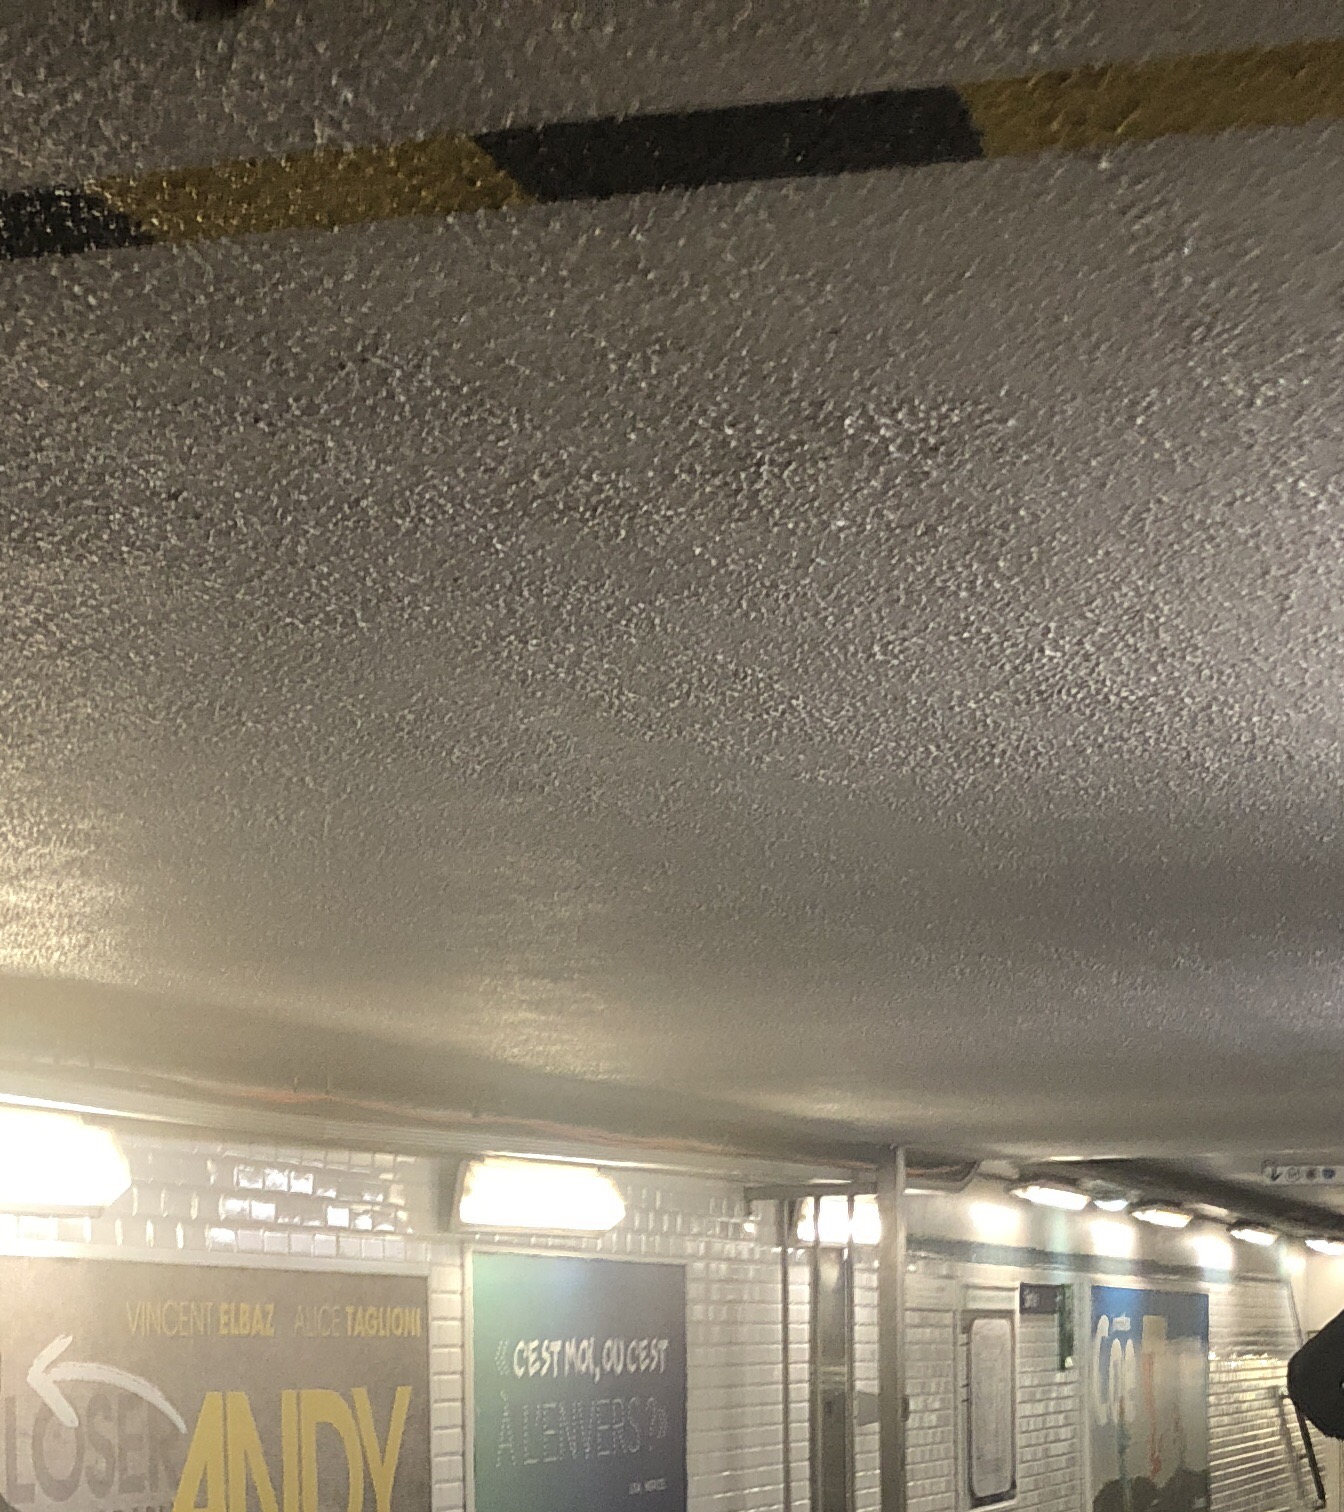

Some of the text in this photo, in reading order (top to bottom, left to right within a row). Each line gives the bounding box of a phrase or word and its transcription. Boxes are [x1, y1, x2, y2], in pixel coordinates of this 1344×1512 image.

[125, 1300, 276, 1337] VINCENT ELBAZ
[294, 1305, 422, 1338] ALICE TAGLIONI
